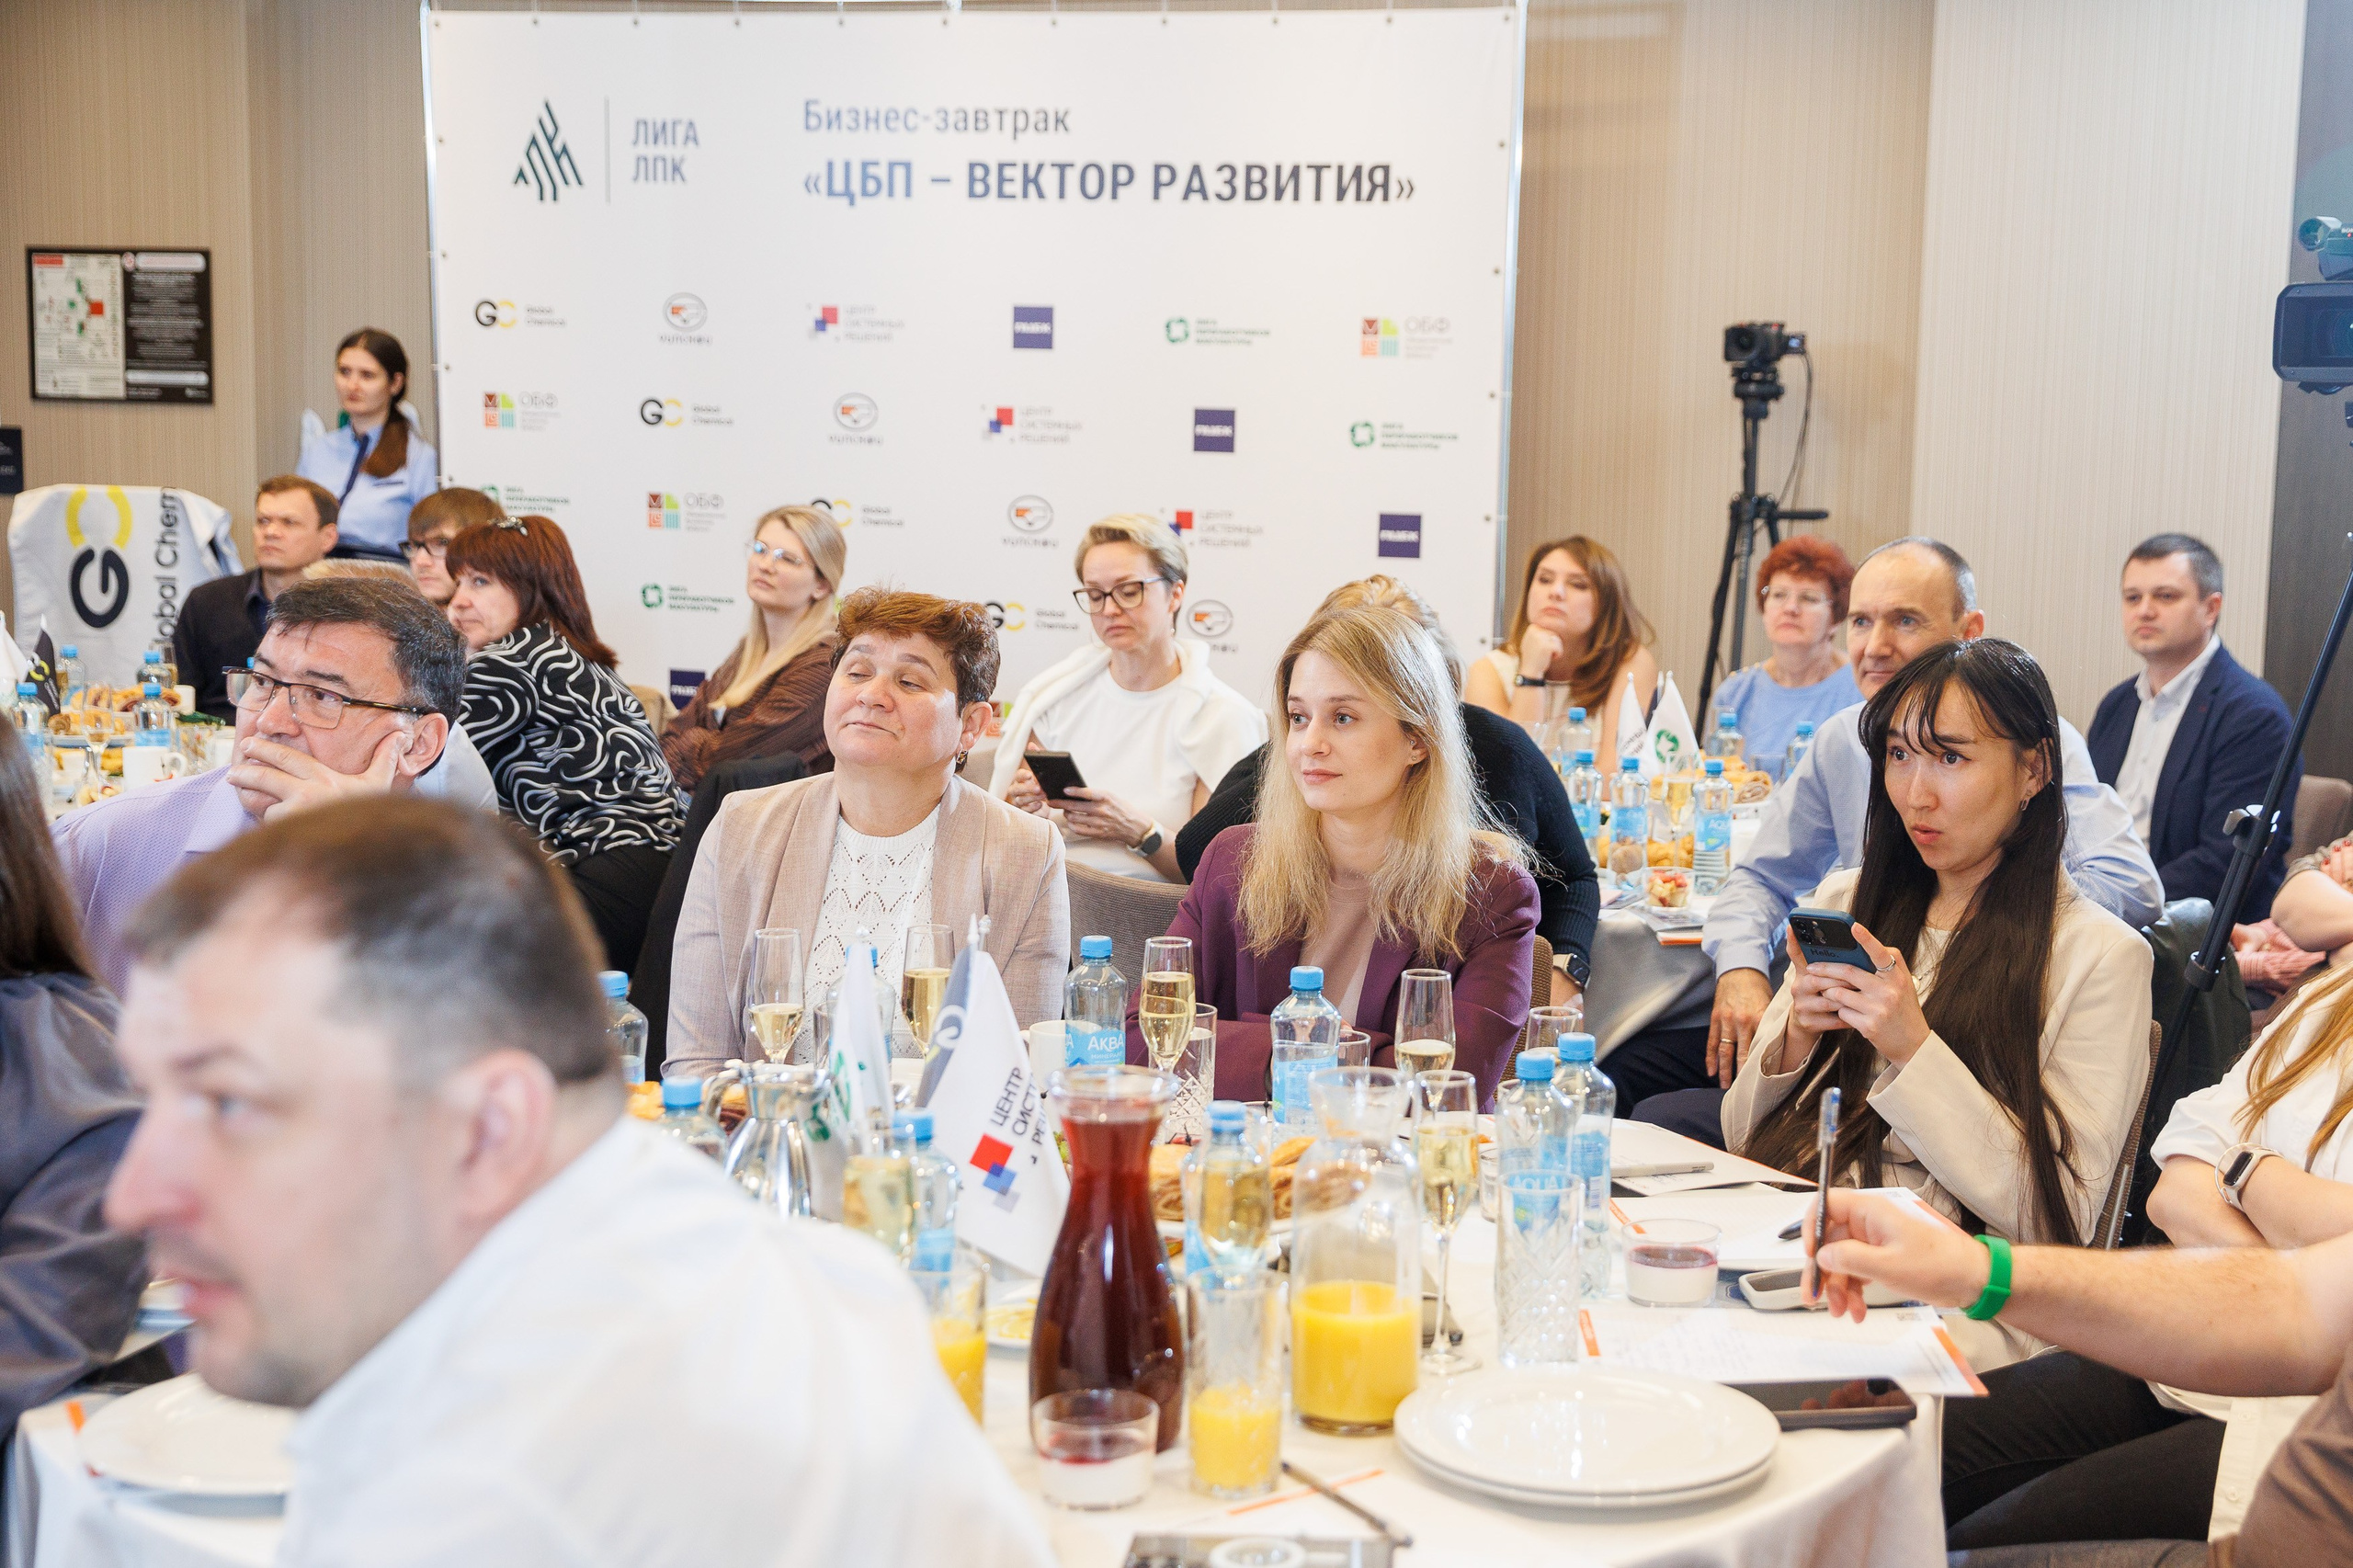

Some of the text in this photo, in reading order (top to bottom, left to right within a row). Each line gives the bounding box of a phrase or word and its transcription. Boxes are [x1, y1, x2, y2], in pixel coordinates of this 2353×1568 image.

[631, 119, 699, 147] ЛИГА
[804, 98, 1070, 142] Бизнес-завтрак
[631, 155, 687, 183] ЛПК
[804, 160, 913, 206] «ЦБП
[968, 162, 1135, 200] ВЕКТОР
[1153, 163, 1415, 202] РАЗВИТИЯ»
[153, 576, 177, 643] lobal
[1810, 949, 1840, 958] Hello.
[990, 1067, 1023, 1127] ЦЕНТР
[1012, 1073, 1038, 1136] СИСТ
